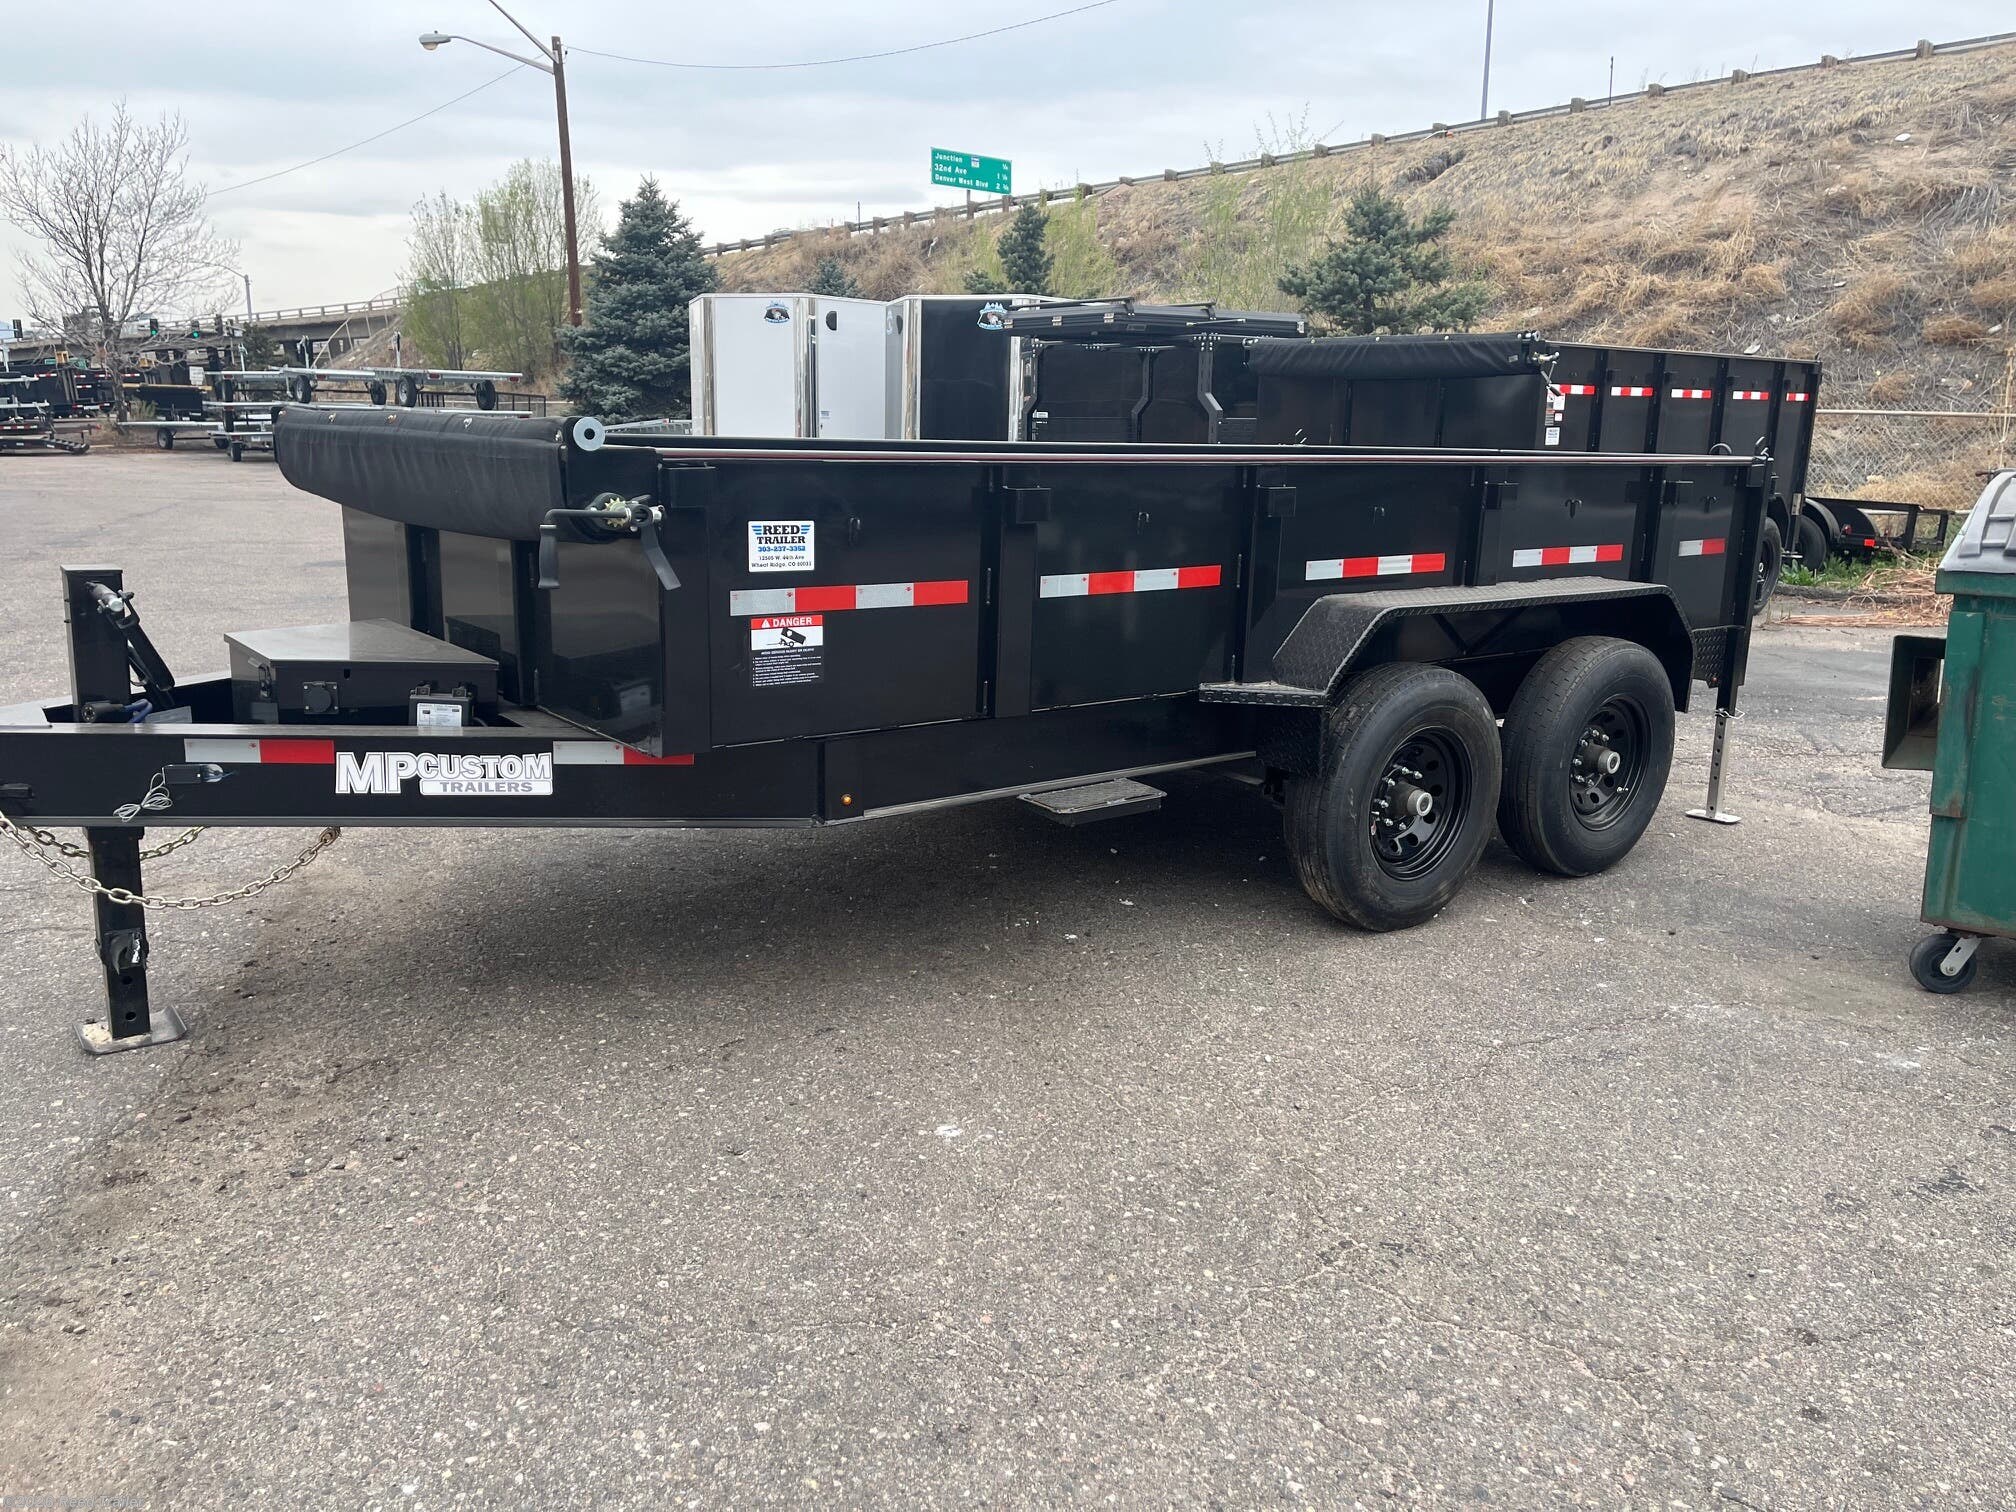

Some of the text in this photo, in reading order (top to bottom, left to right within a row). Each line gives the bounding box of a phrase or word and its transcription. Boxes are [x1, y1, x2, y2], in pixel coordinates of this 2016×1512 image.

[935, 153, 963, 163] Junction
[934, 164, 952, 173] 32nd
[955, 166, 968, 175] Ave
[935, 174, 956, 183] Denver
[958, 177, 973, 186] West
[975, 179, 989, 188] Blvd
[763, 525, 800, 535] REED
[757, 536, 806, 545] TRAILER
[773, 617, 812, 627] DANGER
[440, 781, 533, 793] TRAILERS
